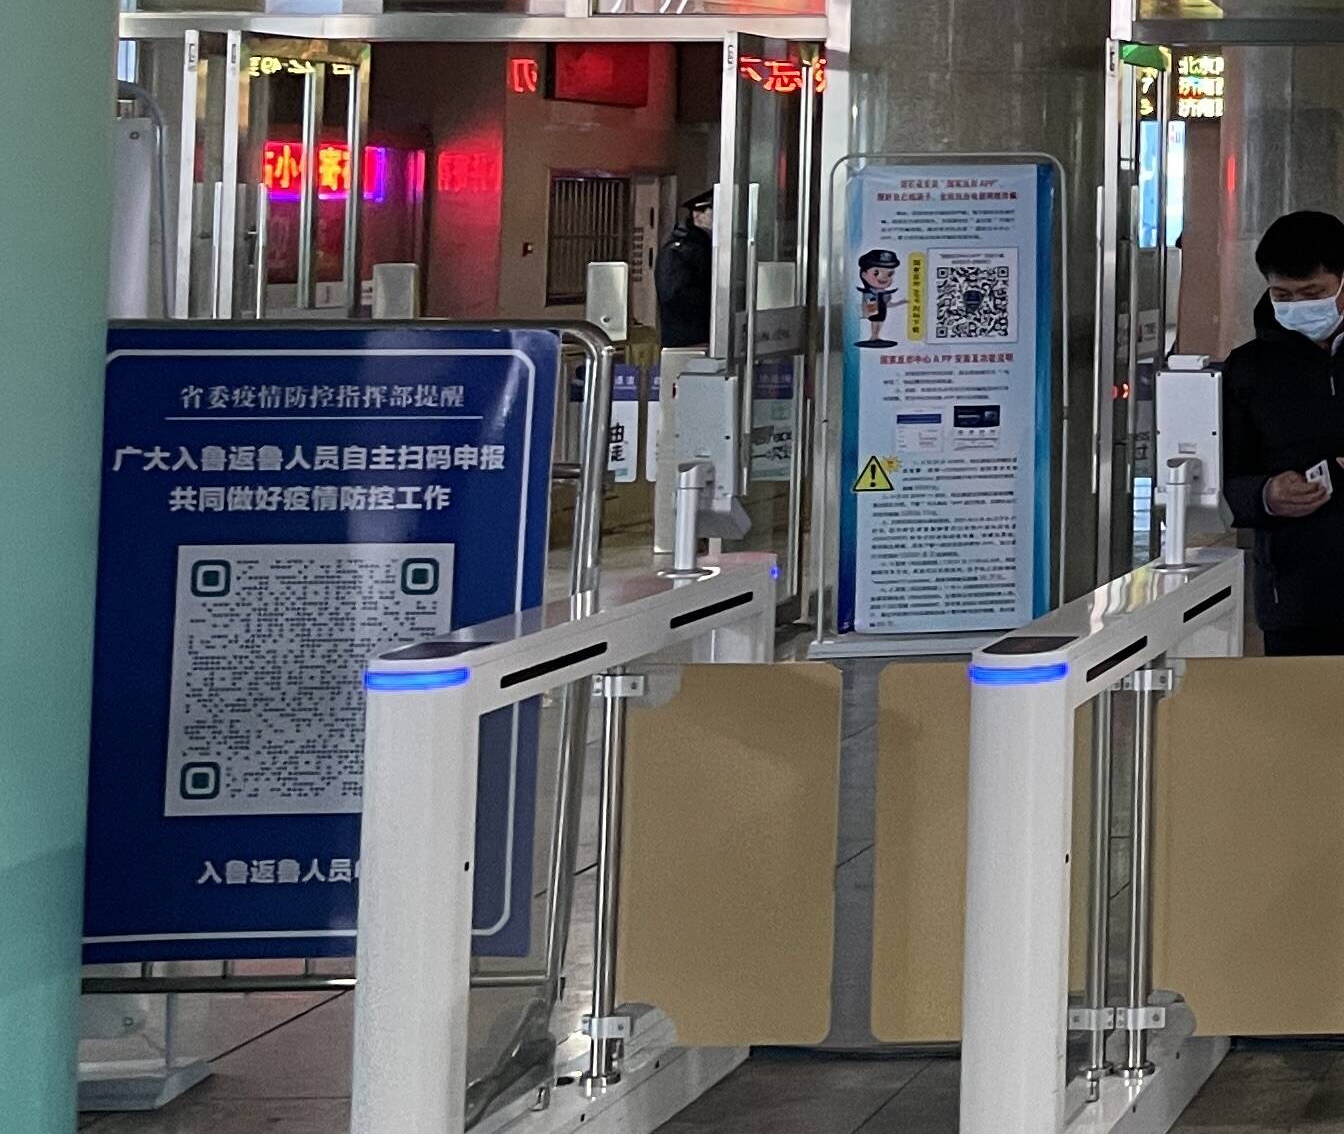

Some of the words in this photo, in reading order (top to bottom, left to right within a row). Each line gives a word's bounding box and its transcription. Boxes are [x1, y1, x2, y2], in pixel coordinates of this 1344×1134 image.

[181, 385, 464, 409] 省委疫情防控指挥部提醒
[112, 444, 505, 472] 广大入鲁返鲁人员自主扫码申报
[168, 485, 452, 512] 共同做好疫情防控工作
[197, 858, 360, 885] 入鲁返鲁人员
